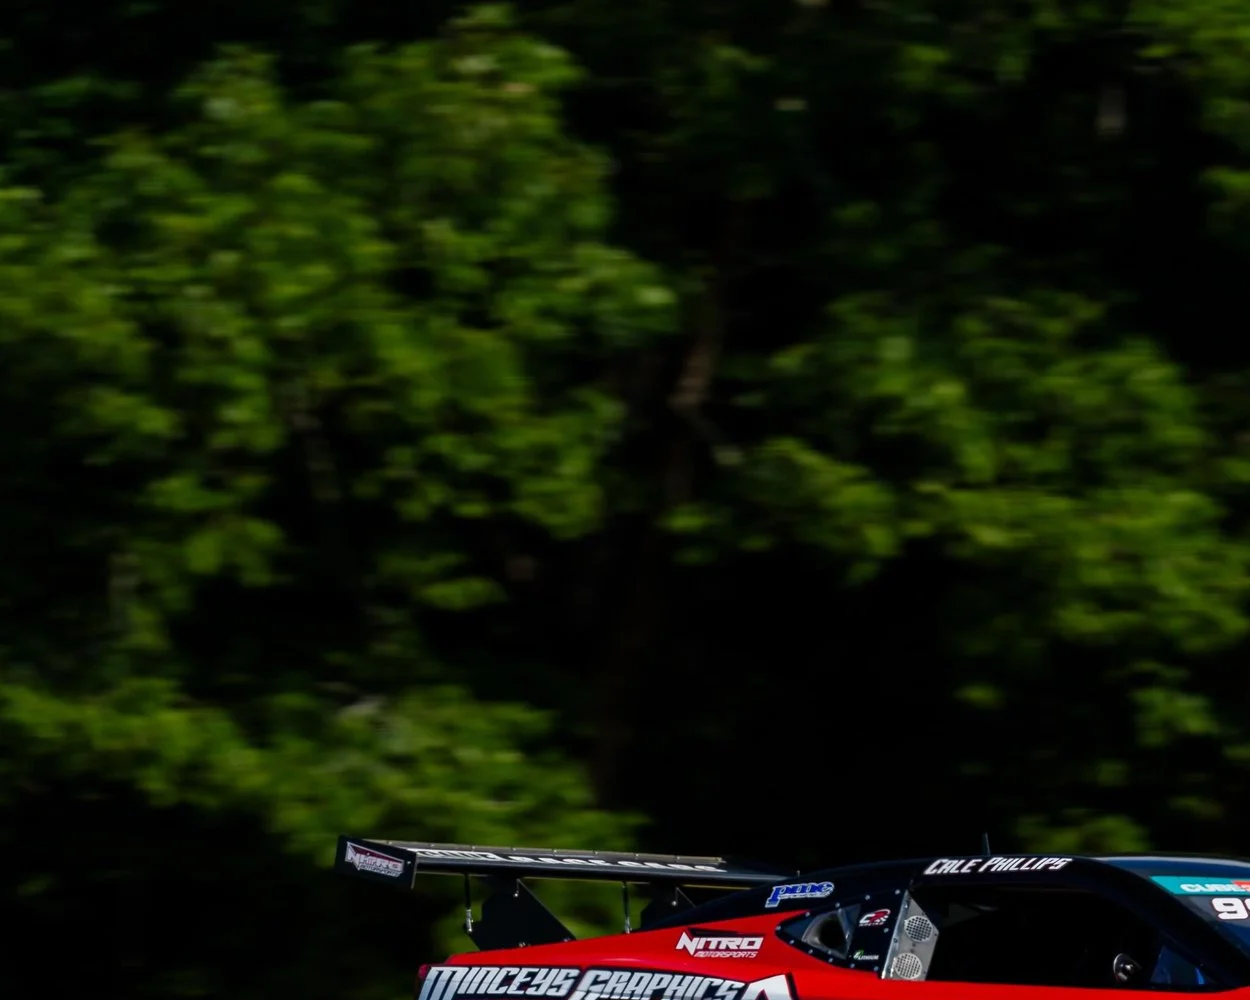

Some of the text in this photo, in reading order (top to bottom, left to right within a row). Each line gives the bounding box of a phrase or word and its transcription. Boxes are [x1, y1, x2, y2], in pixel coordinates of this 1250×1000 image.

[923, 856, 1074, 875] CALE PHILLIPS
[676, 931, 764, 955] NITRO
